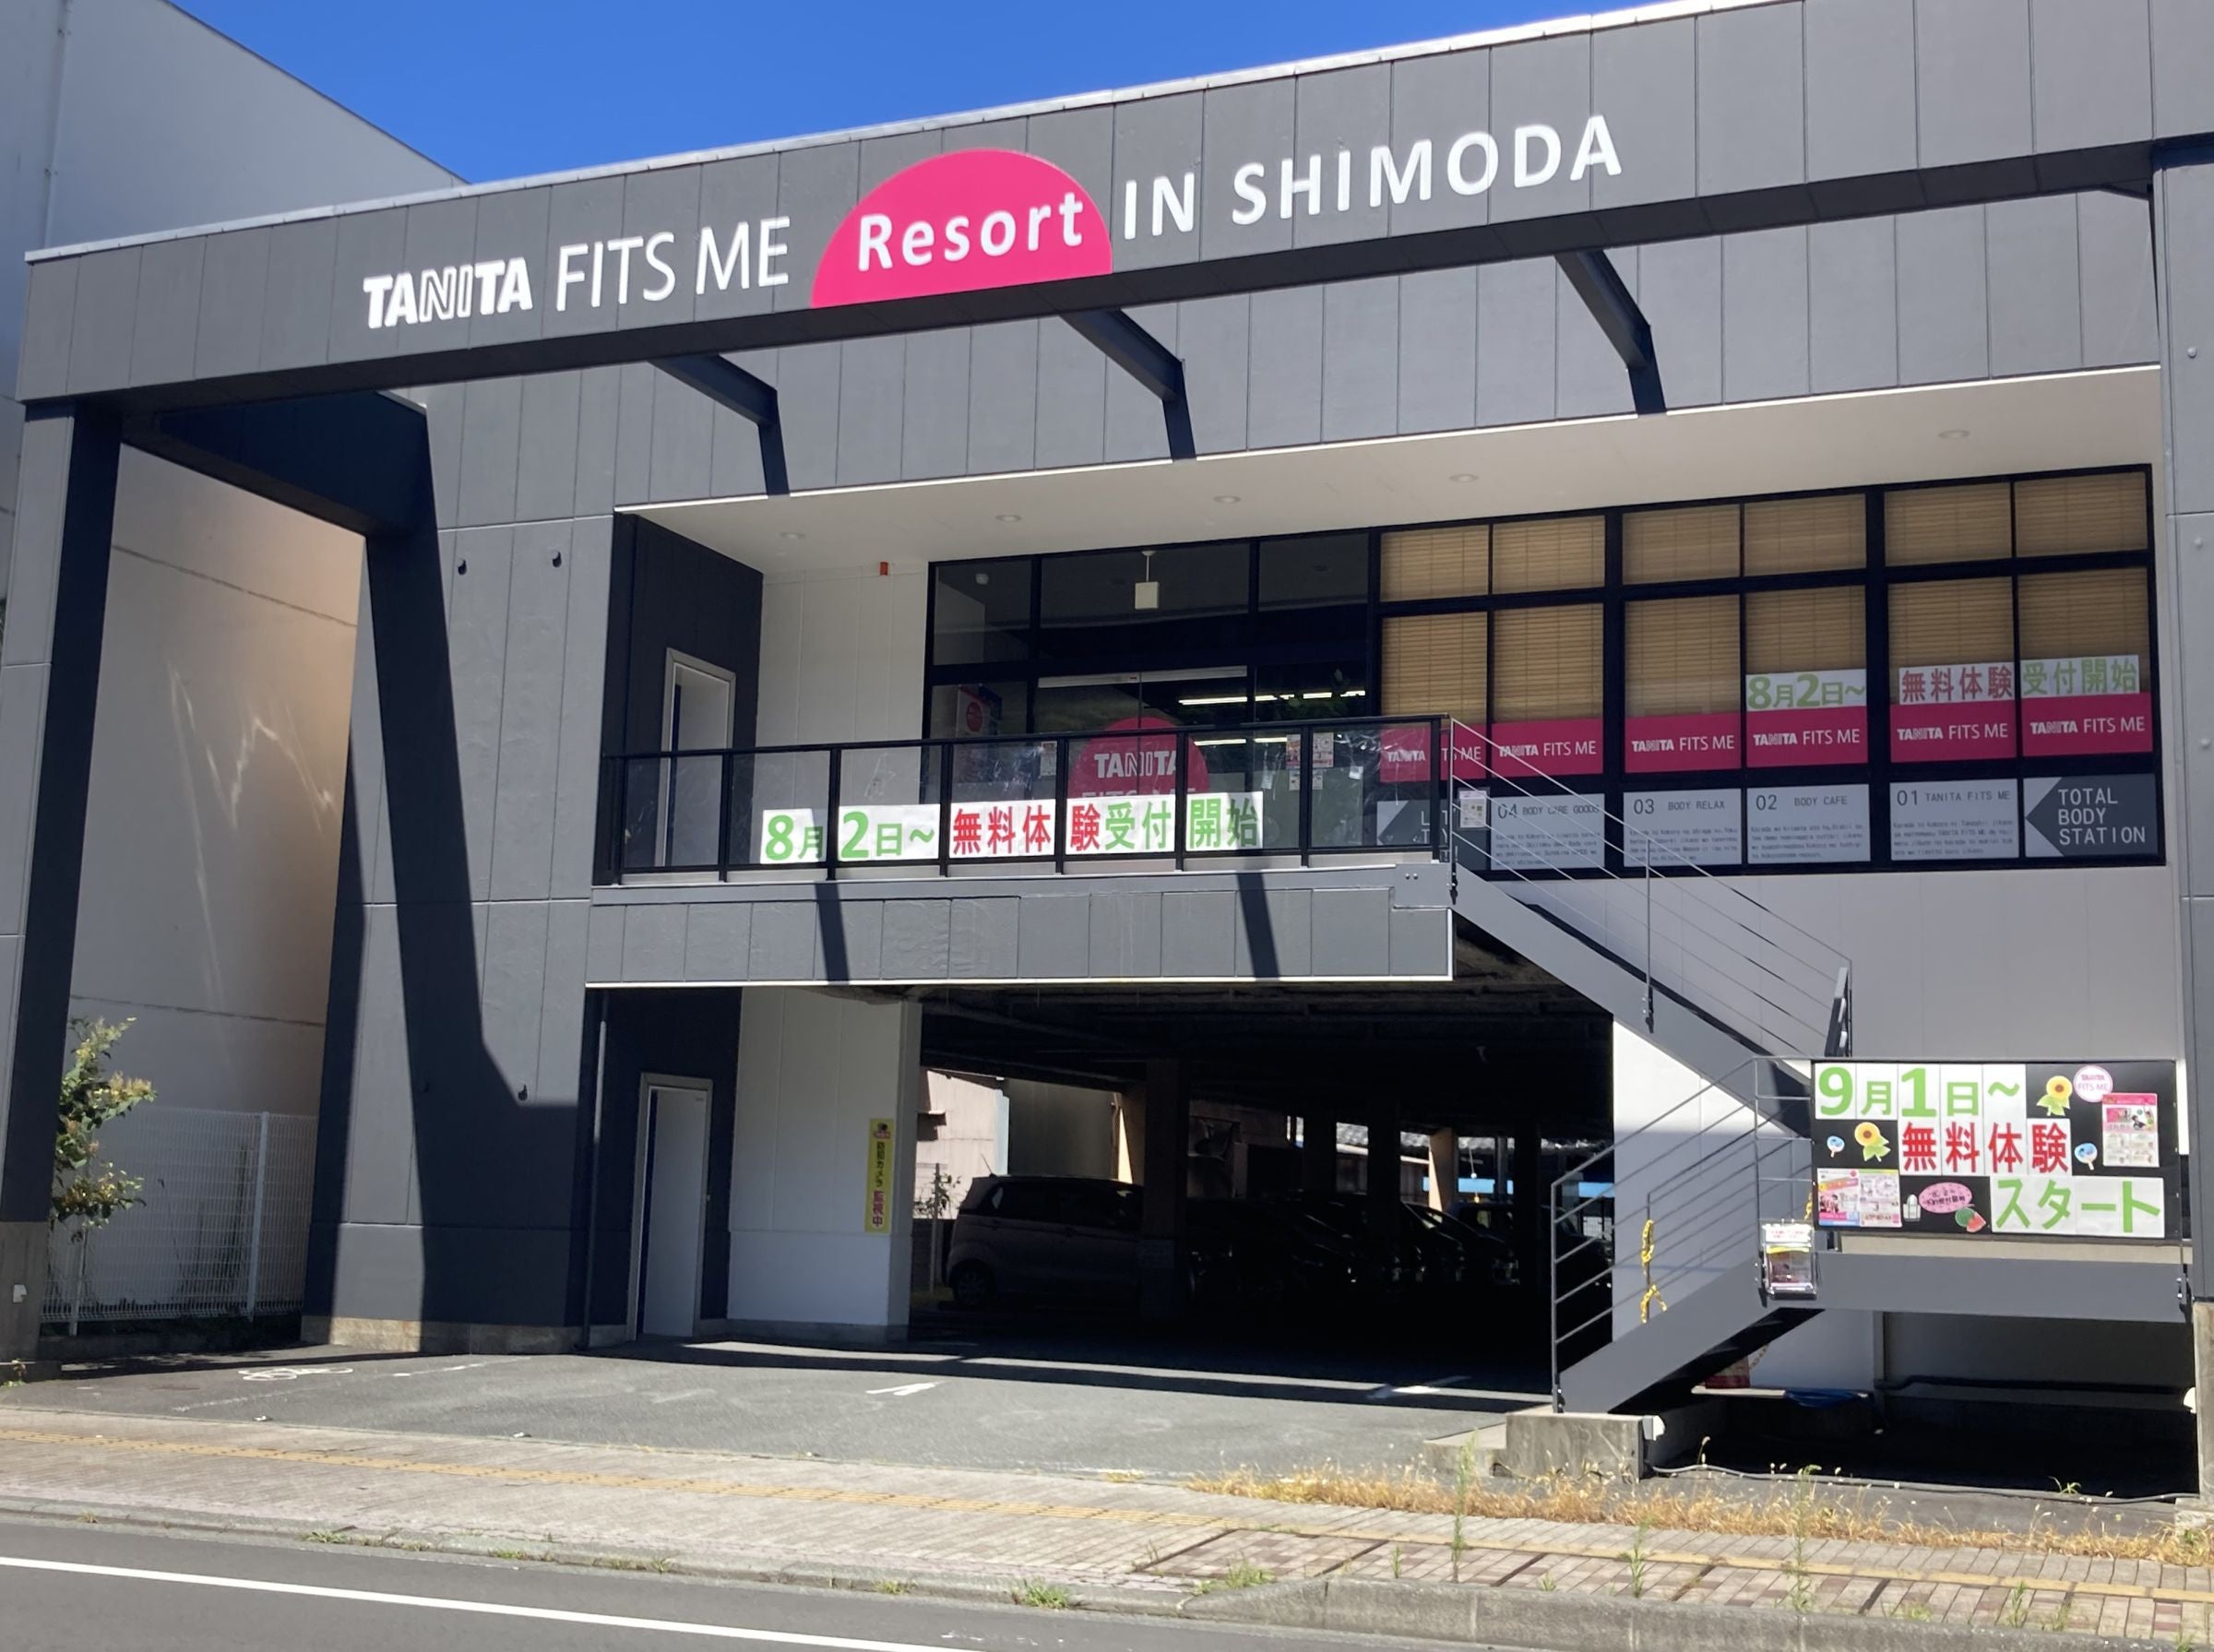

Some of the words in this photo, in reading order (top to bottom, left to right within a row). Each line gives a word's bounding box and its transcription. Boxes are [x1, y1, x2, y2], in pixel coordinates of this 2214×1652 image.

[363, 256, 533, 328] TANITA
[555, 231, 676, 312] FITS
[696, 216, 791, 295] ME
[858, 192, 1084, 272] Resort
[1124, 172, 1196, 241] IN
[1232, 114, 1624, 225] SHIMODA
[1897, 727, 1944, 741] TANITA
[1948, 724, 1980, 740] FITS
[1984, 723, 2008, 738] ME
[2030, 720, 2077, 734] TANITA
[2084, 718, 2116, 732] FITS
[2121, 716, 2145, 731] ME
[1632, 739, 1674, 753] TANITA
[1680, 736, 1708, 751] FITS
[1712, 735, 1734, 749] ME
[1753, 732, 1797, 746] TANITA
[1803, 731, 1835, 745] FITS
[1837, 729, 1860, 743] ME
[1460, 746, 1481, 761] ME
[1499, 743, 1540, 757] TANITA
[1543, 742, 1571, 756] FITS
[1576, 740, 1597, 755] ME
[1633, 798, 1654, 814] 03
[1668, 801, 1691, 811] BODY
[1696, 800, 1725, 810] RELAX
[1756, 794, 1777, 811] 02
[1794, 797, 1817, 806] BODY
[1823, 795, 1848, 805] CAFE
[1897, 790, 1918, 806] 01
[1925, 791, 1961, 802] TANITA
[1967, 790, 1992, 801] FITS
[1997, 790, 2011, 800] ME
[2057, 788, 2118, 806] TOTAL
[1497, 803, 1518, 819] 04
[1522, 806, 1543, 815] BODY
[2057, 807, 2106, 826] BODY
[2059, 826, 2146, 846] STATION
[1902, 1122, 2070, 1173] 無料体験
[1995, 1178, 2160, 1233] スタート
